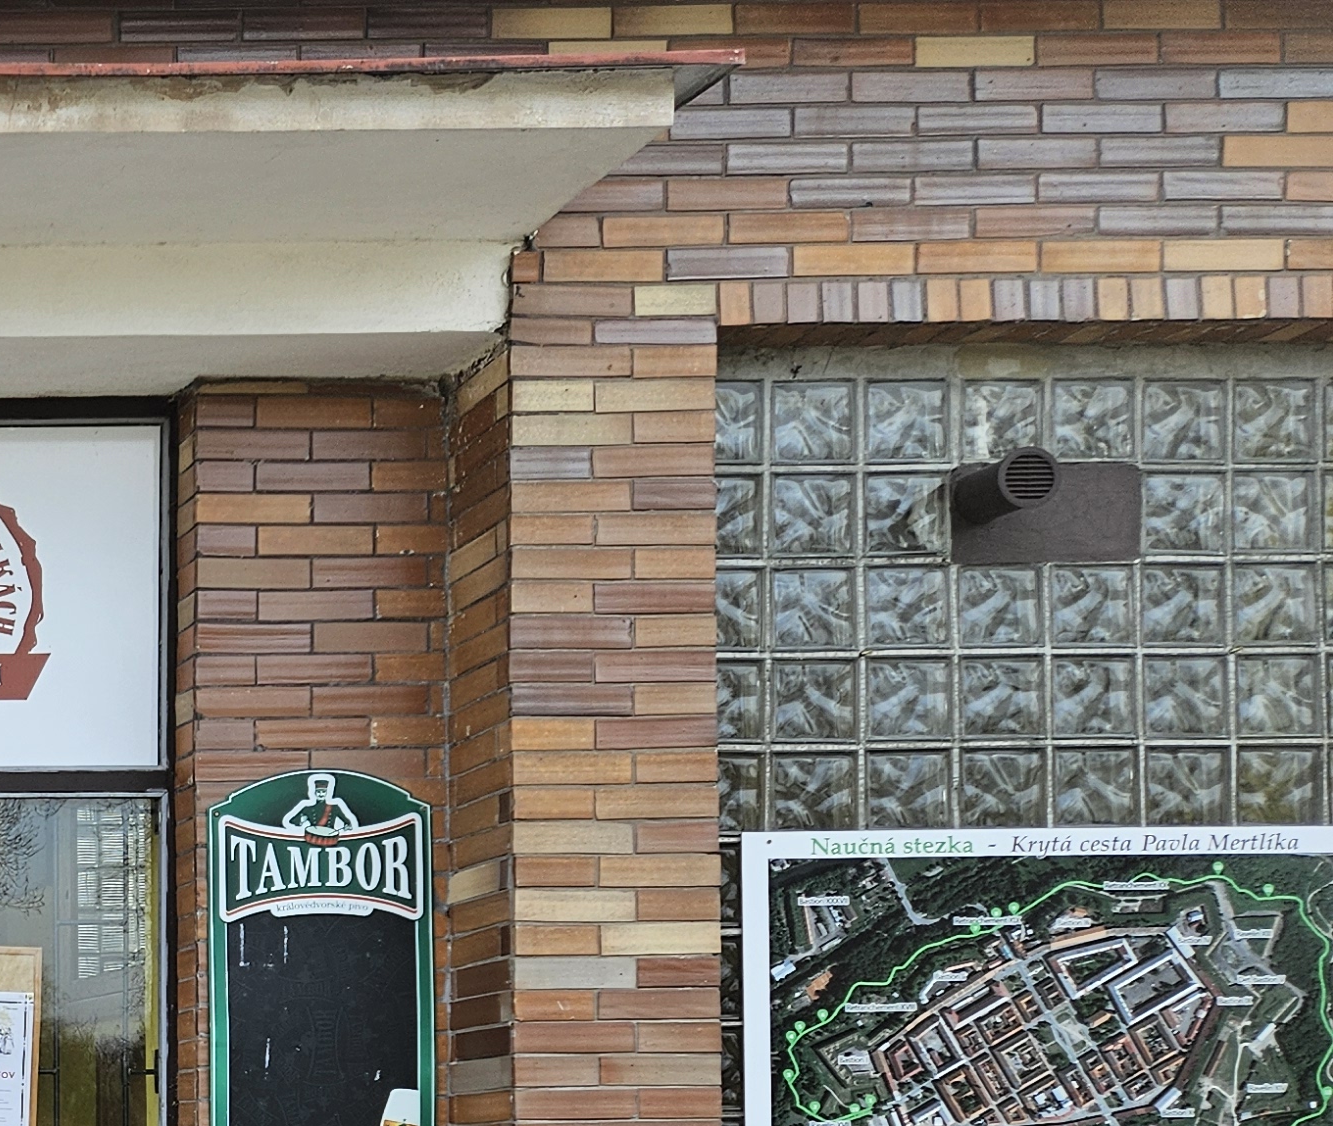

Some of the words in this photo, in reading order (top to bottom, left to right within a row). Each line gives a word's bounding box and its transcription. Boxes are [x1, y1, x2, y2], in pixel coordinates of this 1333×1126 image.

[231, 835, 412, 900] TAMBOR
[810, 835, 896, 855] Naučná
[902, 837, 974, 854] stezka
[1011, 835, 1072, 860] Krytá
[1080, 838, 1132, 853] cesta
[1141, 834, 1200, 853] Pavla
[1206, 832, 1299, 853] Mertlíka
